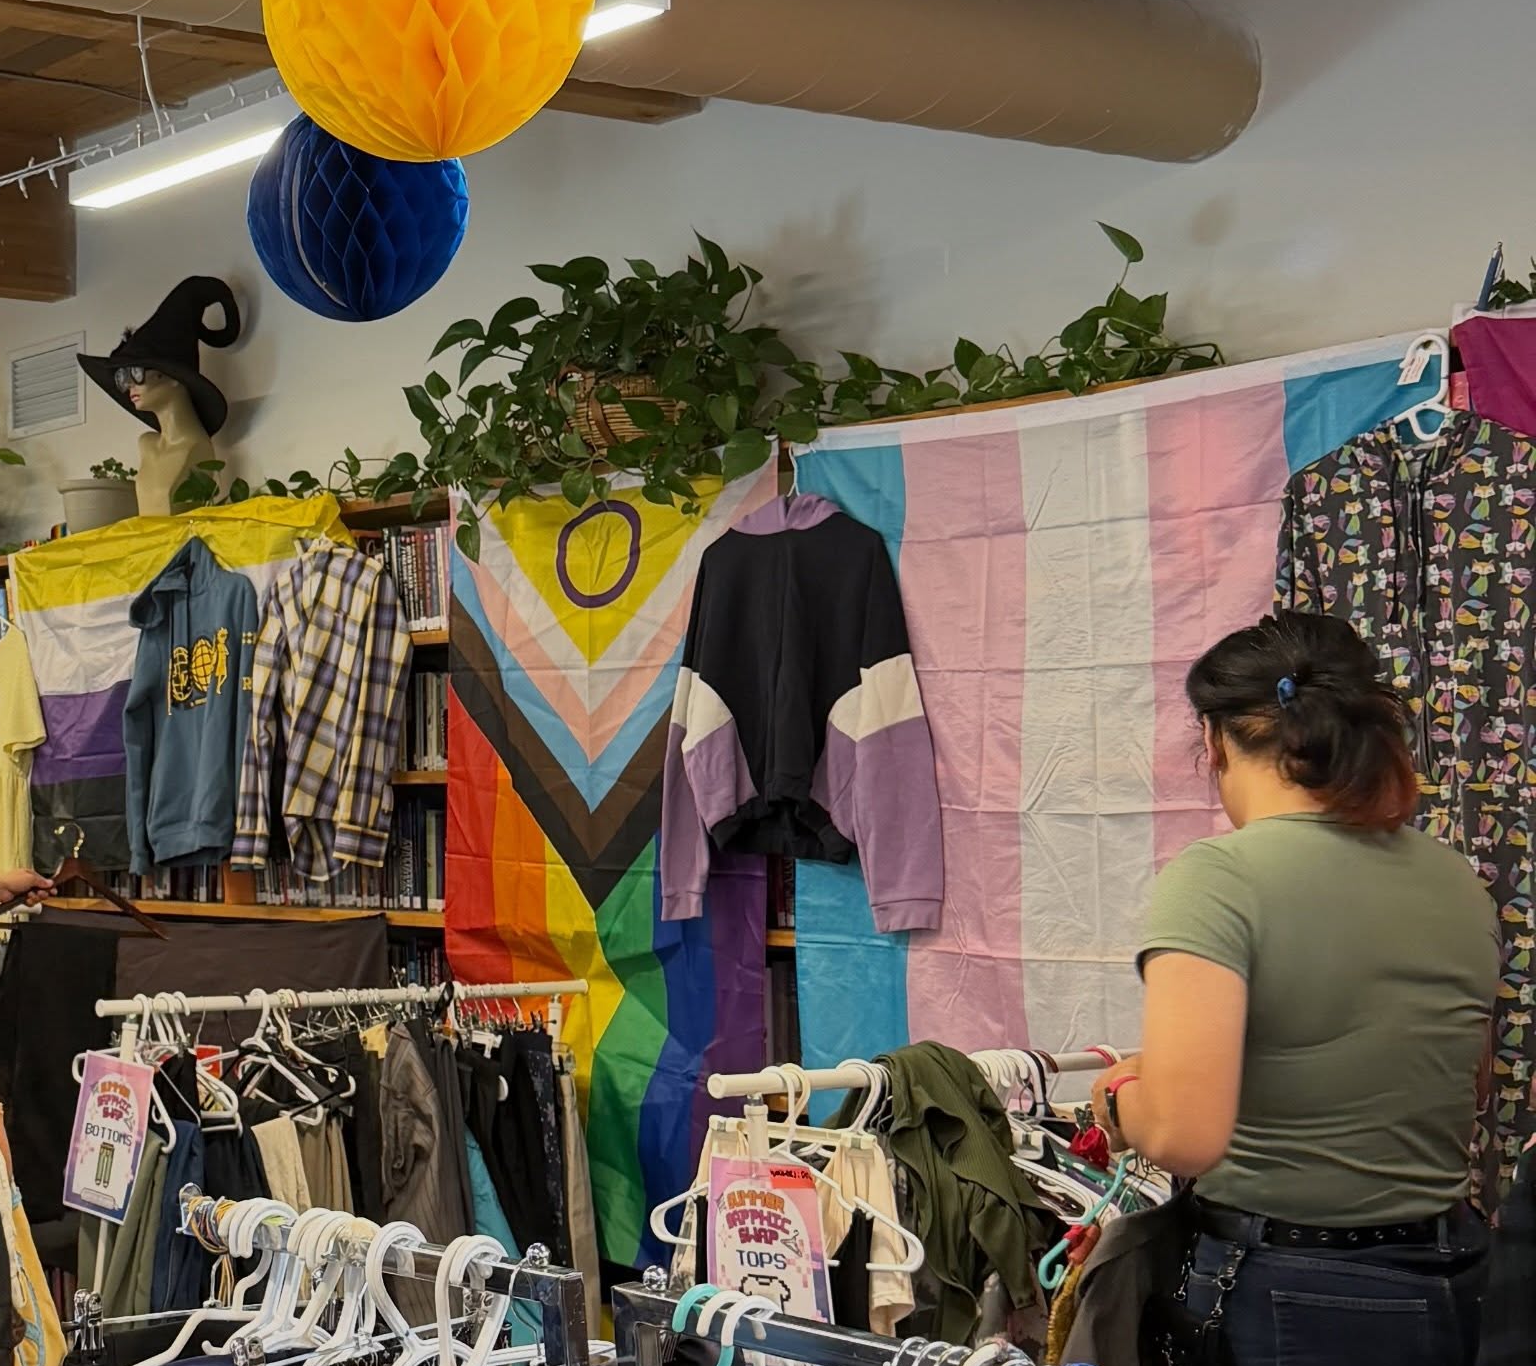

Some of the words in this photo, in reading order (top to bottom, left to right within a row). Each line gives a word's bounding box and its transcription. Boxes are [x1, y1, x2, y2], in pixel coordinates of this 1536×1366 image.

[84, 1122, 133, 1147] BOTTOMS
[737, 1225, 779, 1246] SWAP
[735, 1249, 787, 1270] TOPS
